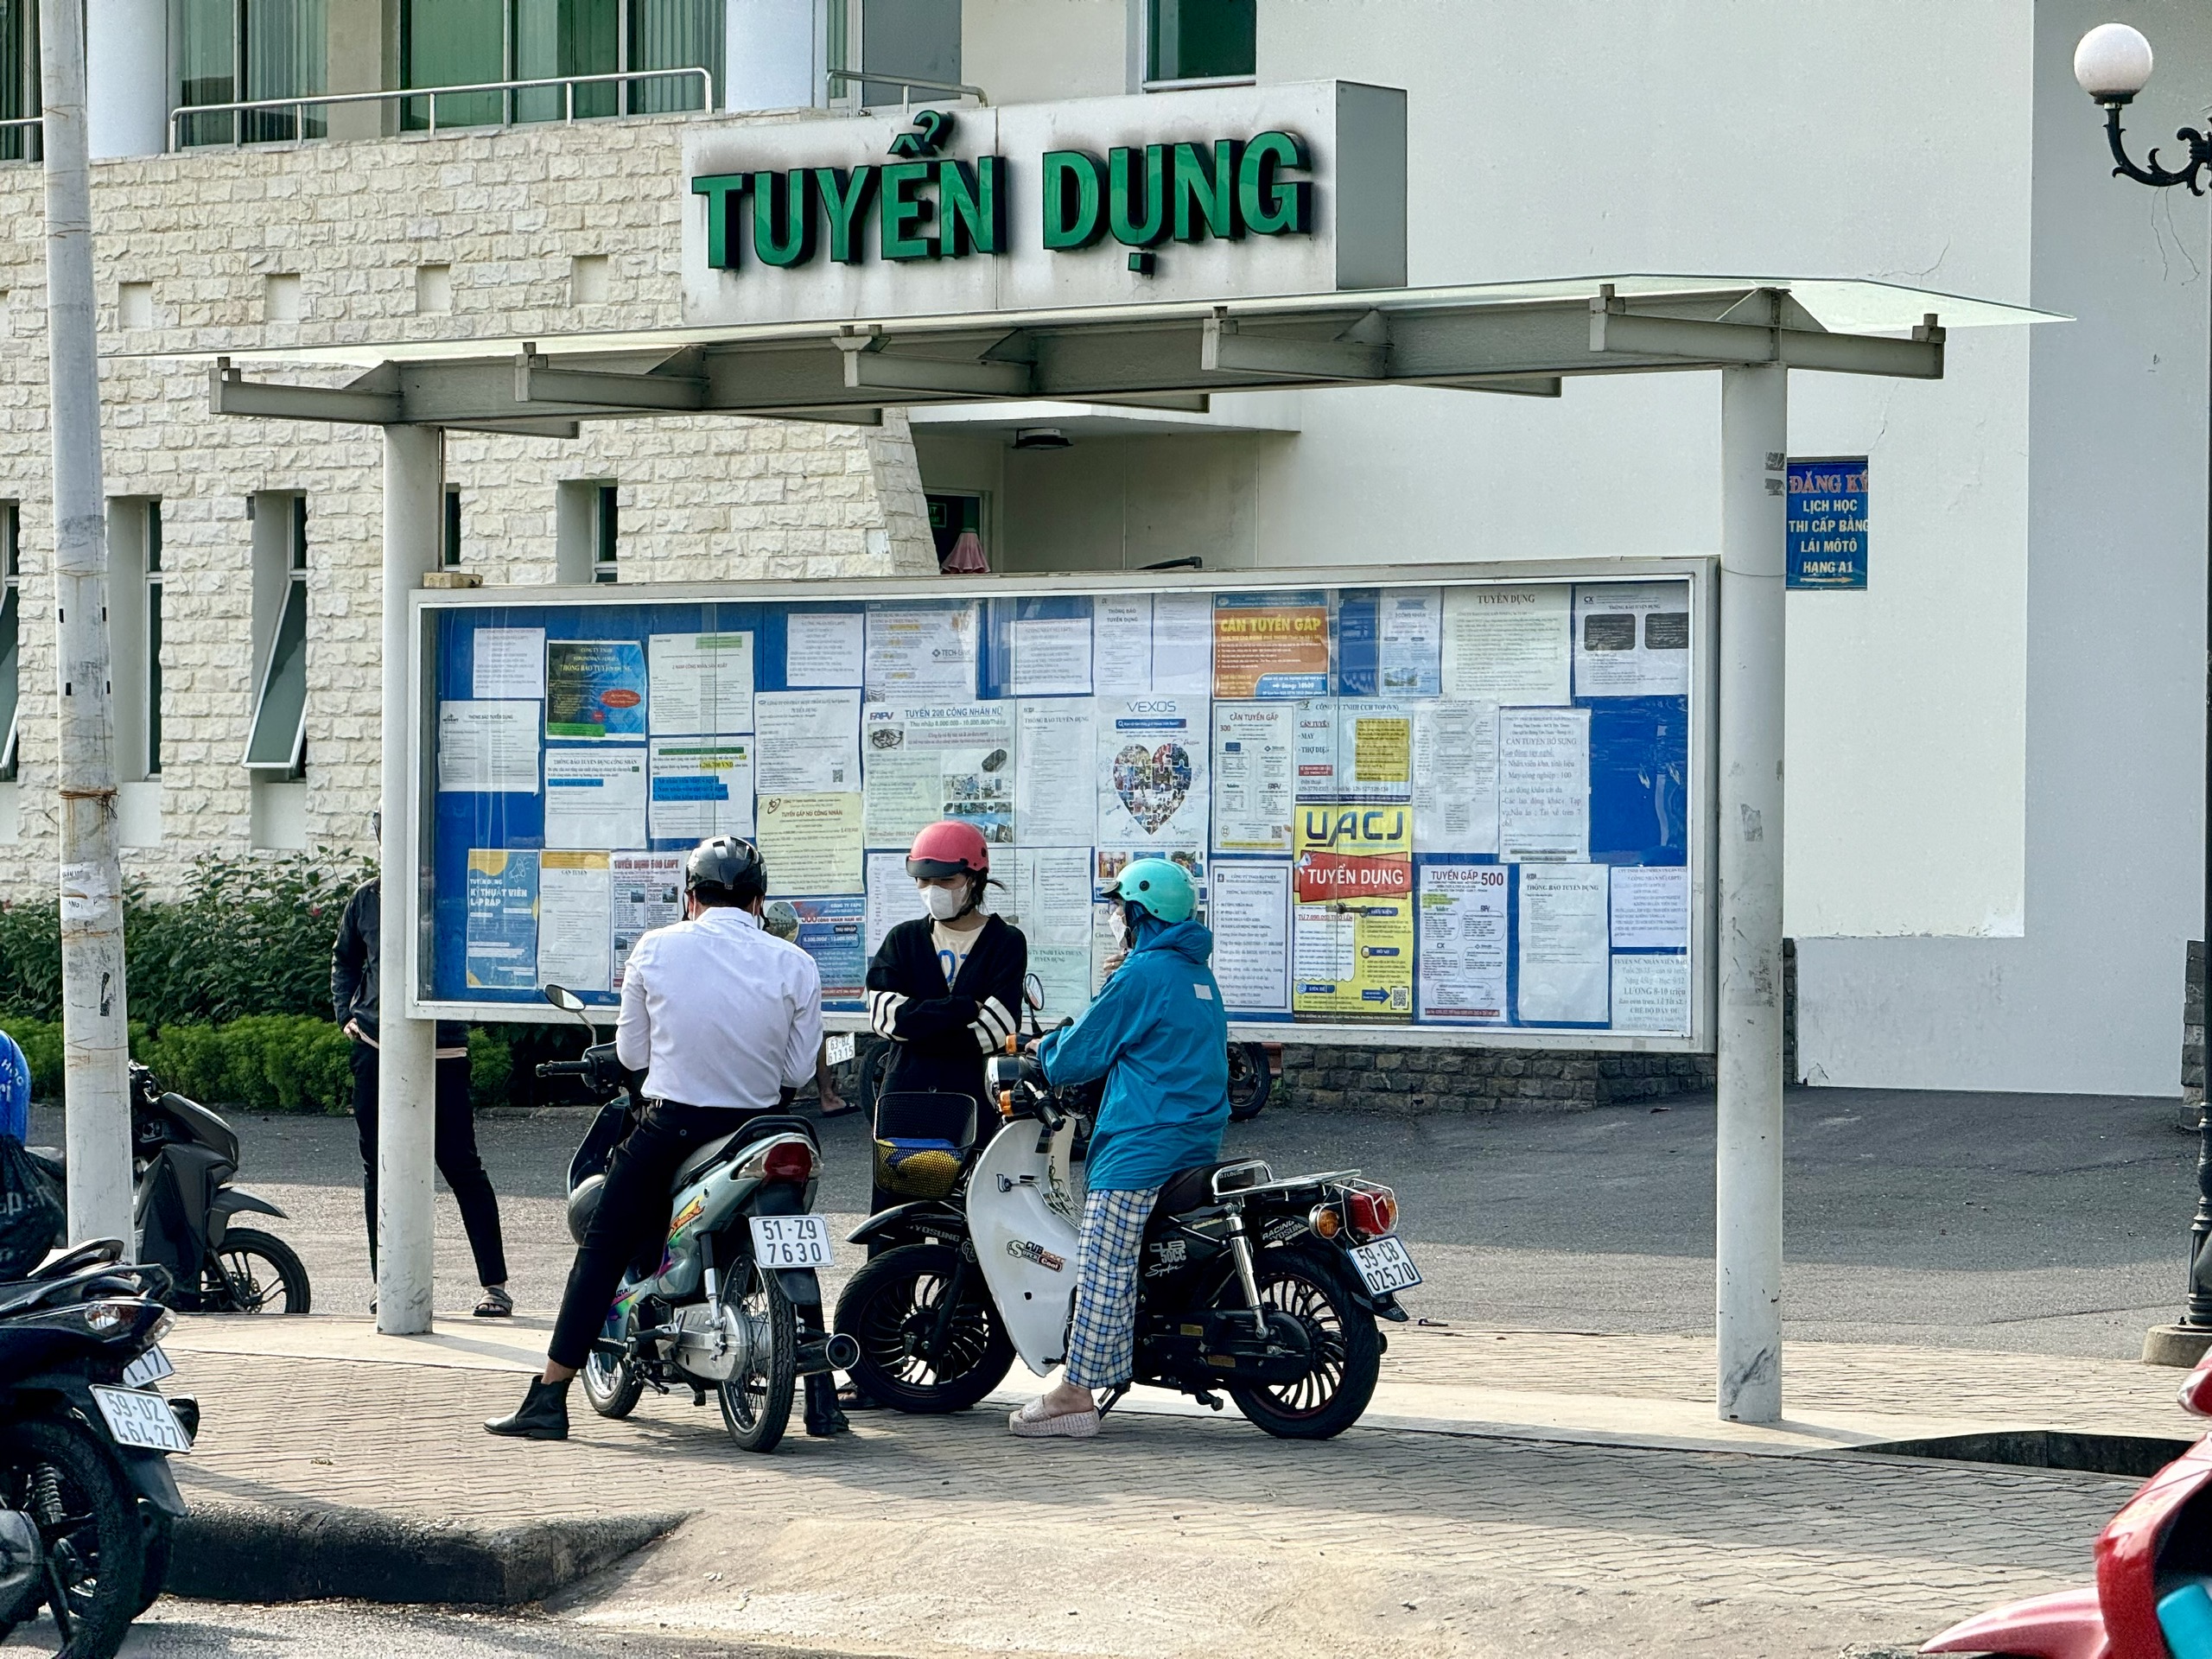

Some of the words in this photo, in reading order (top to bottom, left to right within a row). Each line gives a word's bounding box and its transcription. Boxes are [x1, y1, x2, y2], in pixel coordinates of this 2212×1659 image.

[691, 110, 1007, 270] TUYỂN
[1042, 130, 1313, 275] DỤNG
[1789, 471, 1841, 493] ĐĂNG
[1846, 469, 1868, 493] KÝ
[1802, 499, 1829, 514] LỊCH
[1834, 499, 1858, 513] HỌC
[1789, 520, 1808, 532] THI
[1812, 515, 1836, 532] CẤP
[1839, 514, 1868, 532] BẰNG
[1801, 537, 1820, 552] LÁI
[1824, 537, 1857, 552] MÔTÔ
[1838, 561, 1853, 573] A1
[1510, 594, 1535, 605] DỤNG
[1220, 614, 1246, 632] CẦN
[1249, 614, 1290, 632] TUYỂN
[1294, 614, 1321, 632] GẤP
[1127, 701, 1176, 712] VEXOS
[1305, 810, 1403, 848] UACJ
[1307, 862, 1357, 885] TUYỂN
[1360, 868, 1404, 888] DỤNG
[1430, 868, 1459, 880] TUYỂN
[1460, 869, 1478, 880] GẤP
[1481, 872, 1504, 887] 500
[762, 1219, 817, 1241] 51-Z9
[766, 1242, 822, 1264] 7630
[1366, 1262, 1415, 1292] 025.70
[113, 1418, 180, 1449] 464.27
